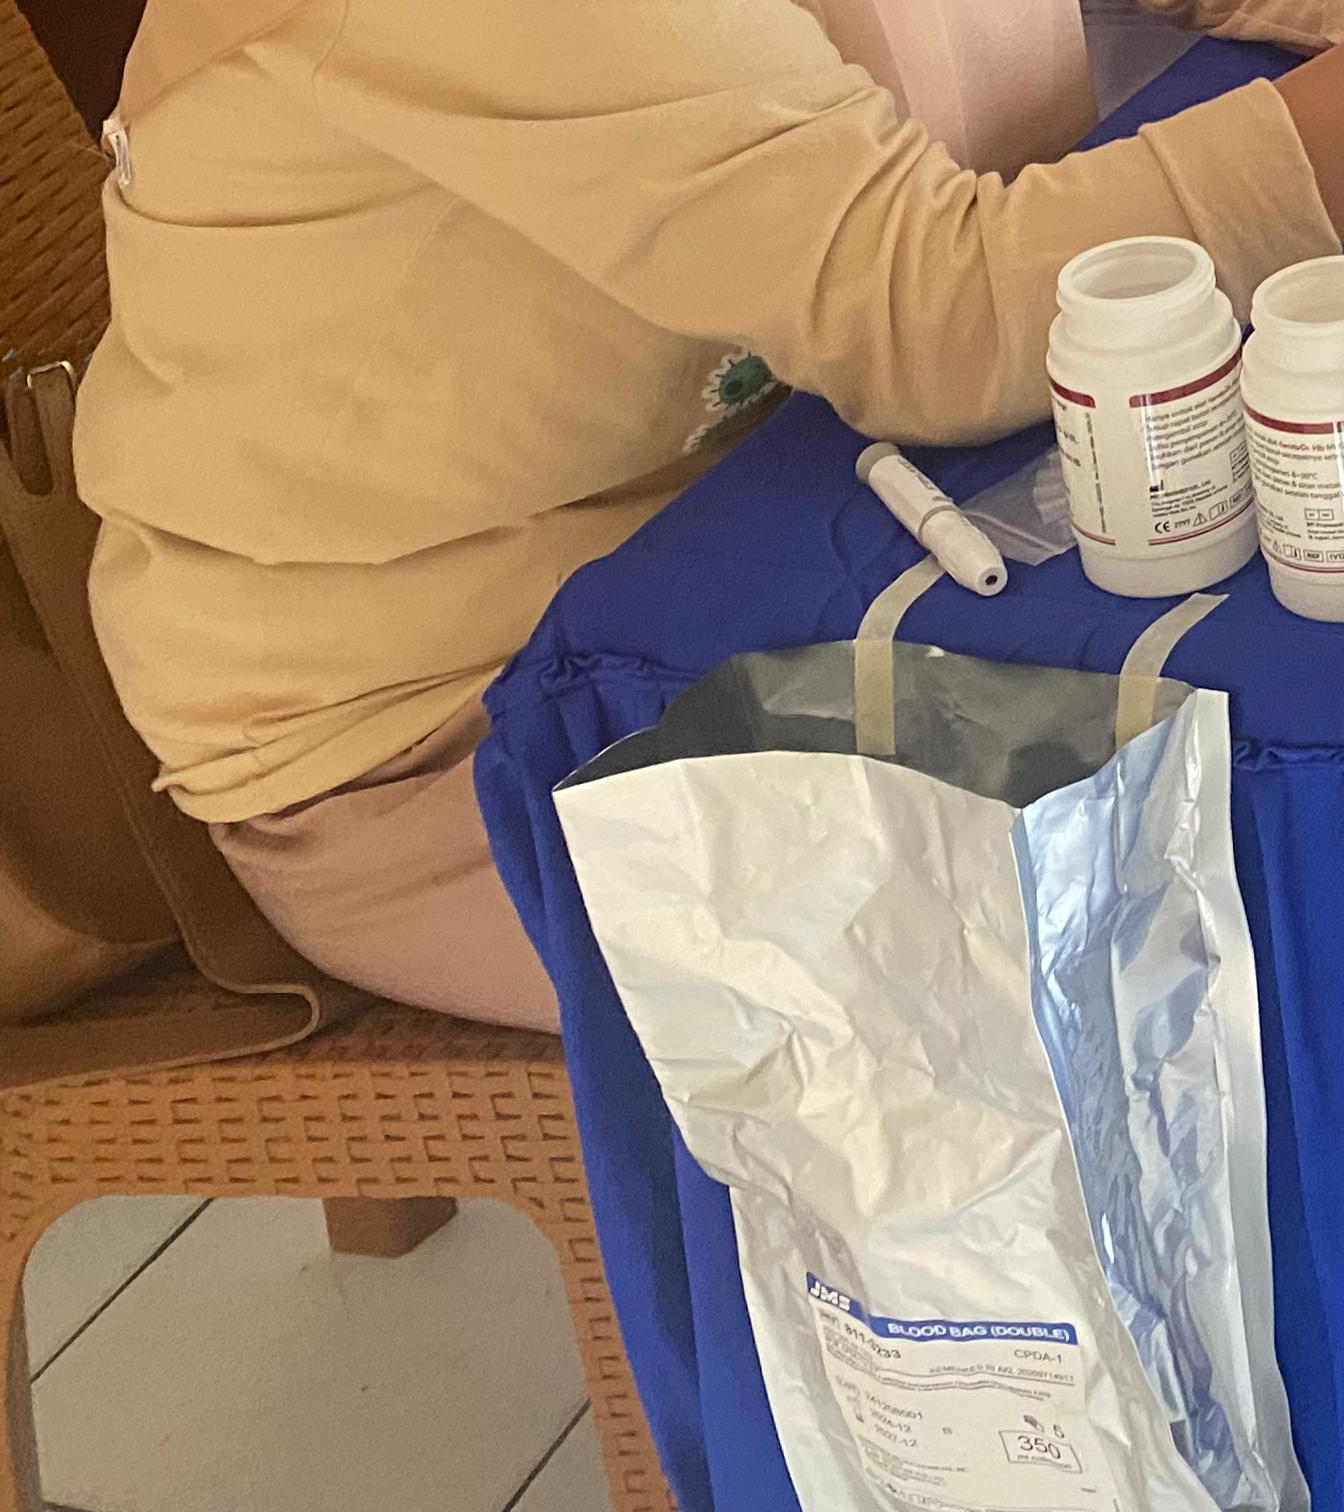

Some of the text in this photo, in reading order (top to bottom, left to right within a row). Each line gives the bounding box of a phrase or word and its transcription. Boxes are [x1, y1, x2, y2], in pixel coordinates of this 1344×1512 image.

[810, 1280, 850, 1311] JMS
[888, 1323, 1070, 1341] BLOOD BAG (DOUBLE)
[1014, 1349, 1062, 1364] CPDA-1
[1053, 1424, 1065, 1438] 5
[1018, 1435, 1061, 1459] 350
